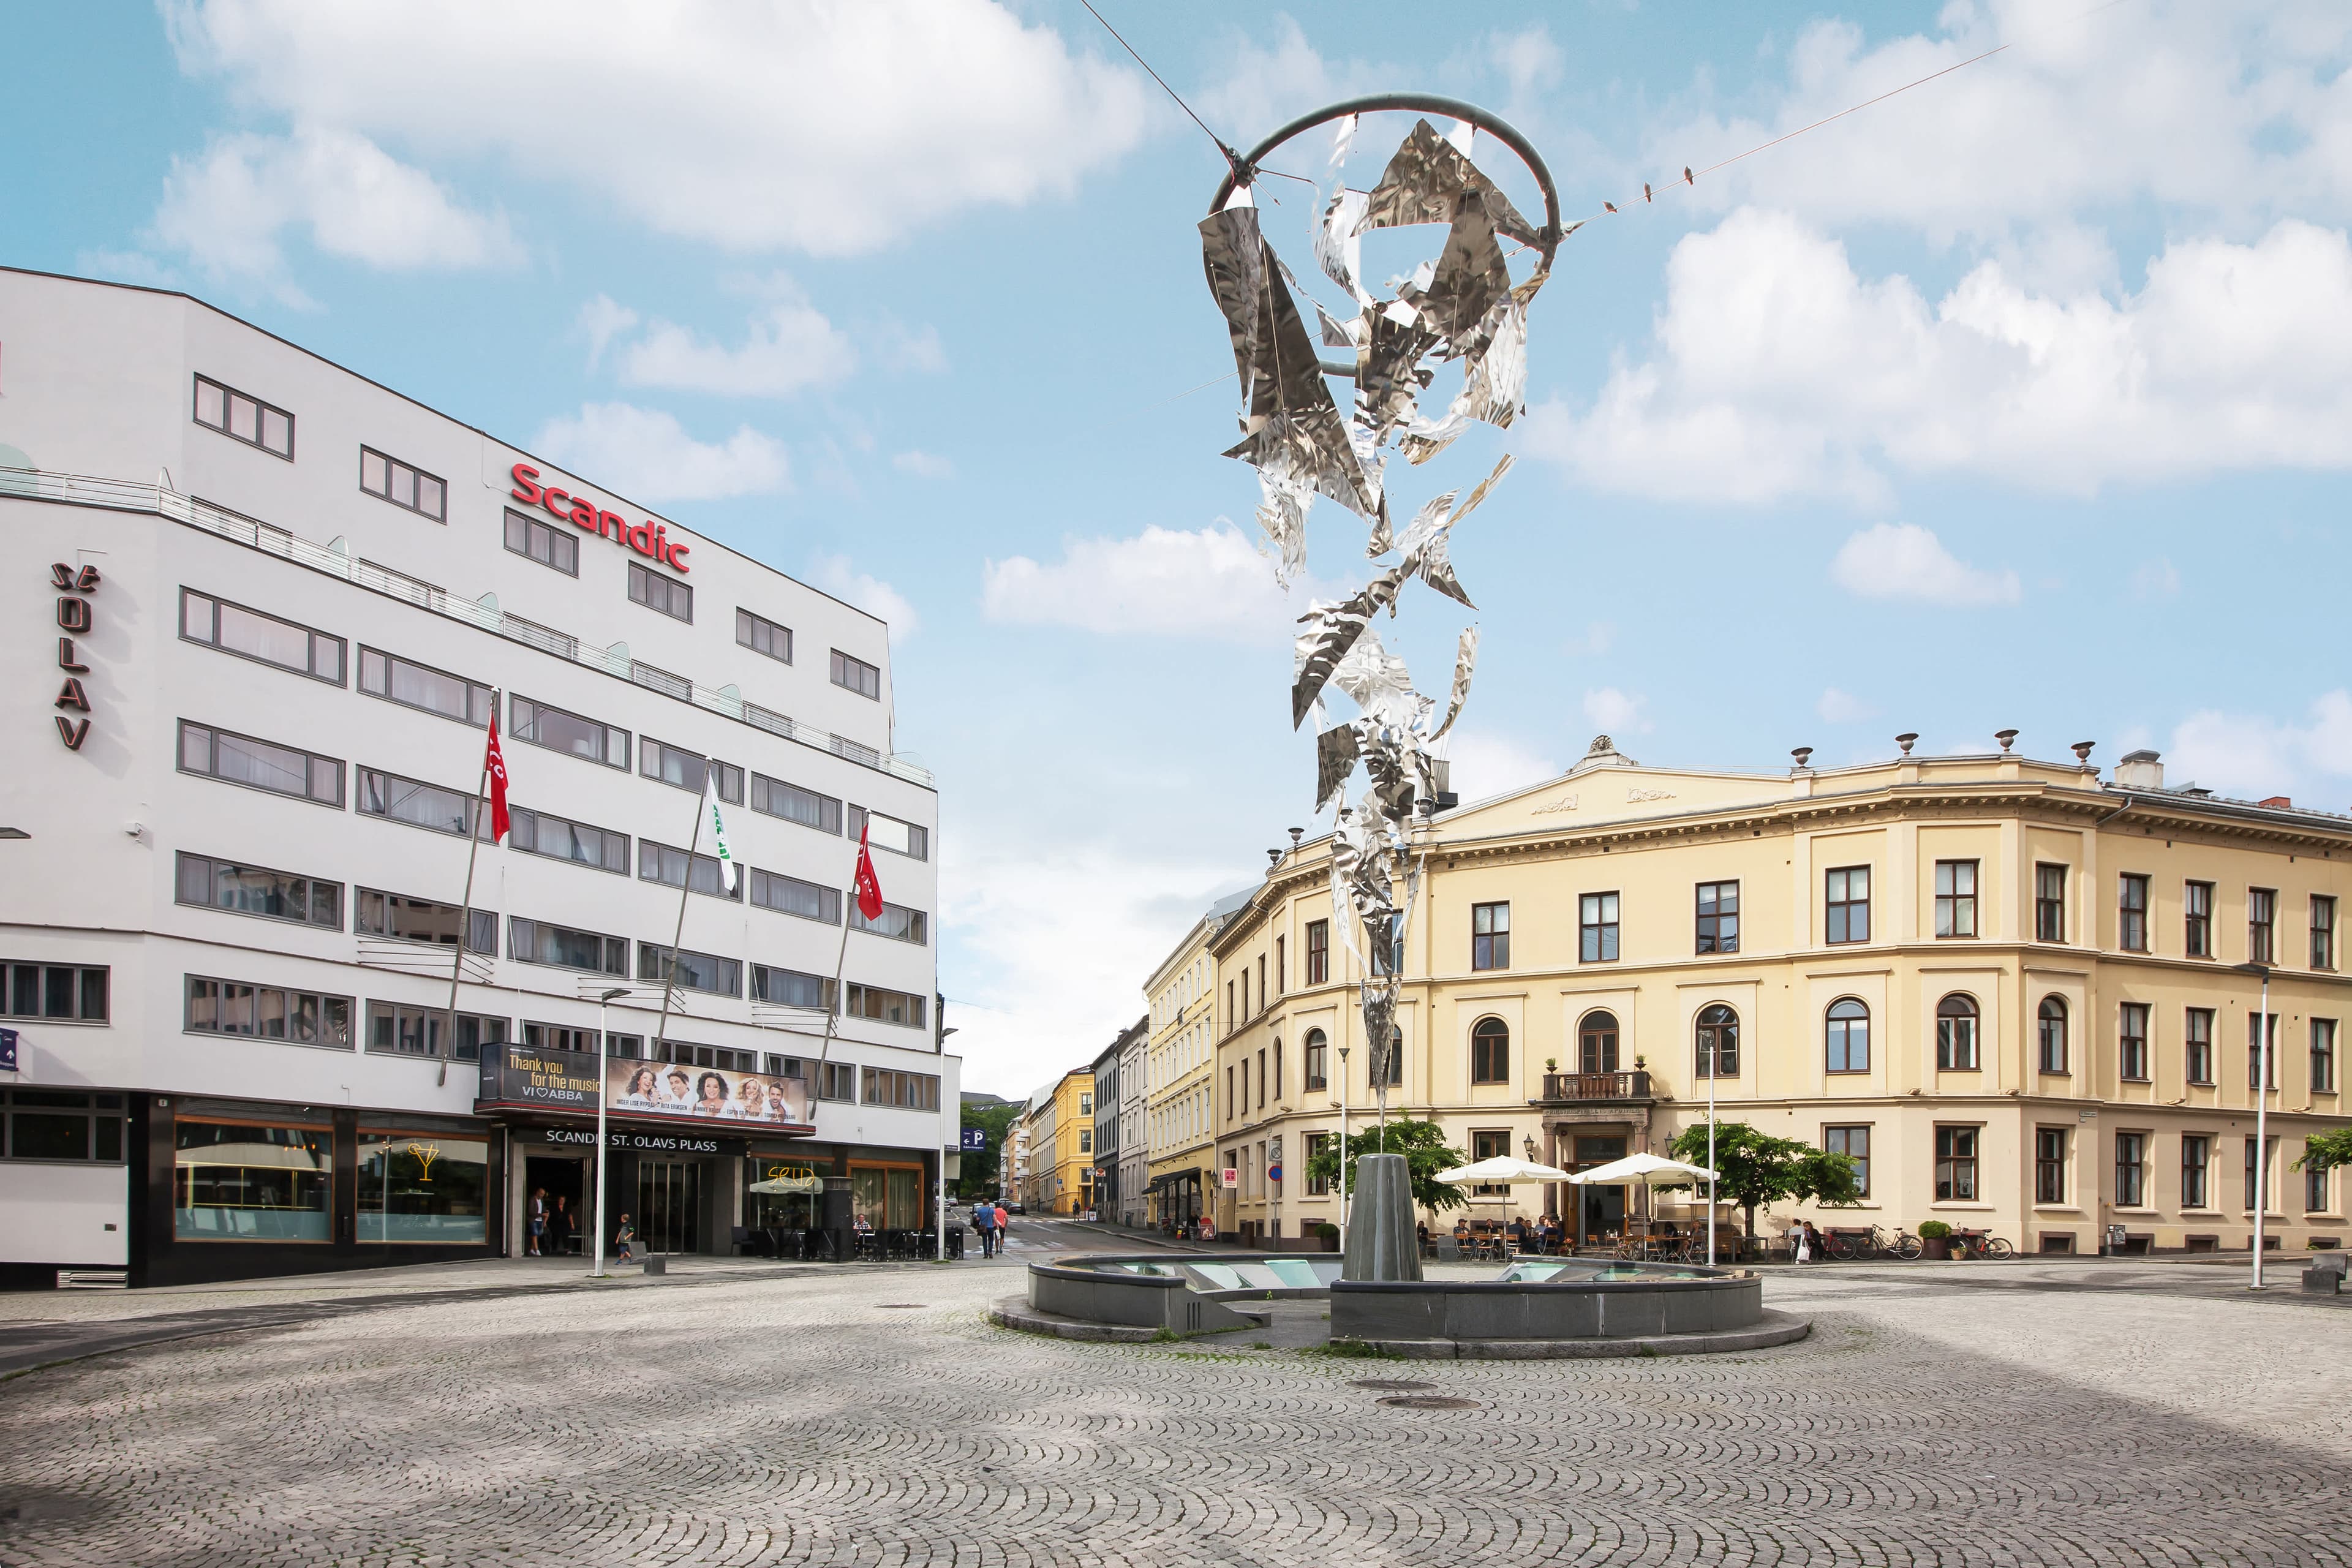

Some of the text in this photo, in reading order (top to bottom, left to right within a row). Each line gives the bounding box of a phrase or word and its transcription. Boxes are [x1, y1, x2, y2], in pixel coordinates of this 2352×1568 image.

[512, 463, 690, 573] Scandic
[54, 596, 92, 750] OLAV
[509, 1055, 563, 1074] Thank you
[531, 1072, 600, 1093] for the music
[522, 1086, 584, 1101] VI ABBA
[546, 1130, 717, 1152] SCANDI ST. OLAVS PLASS
[974, 1133, 983, 1145] P
